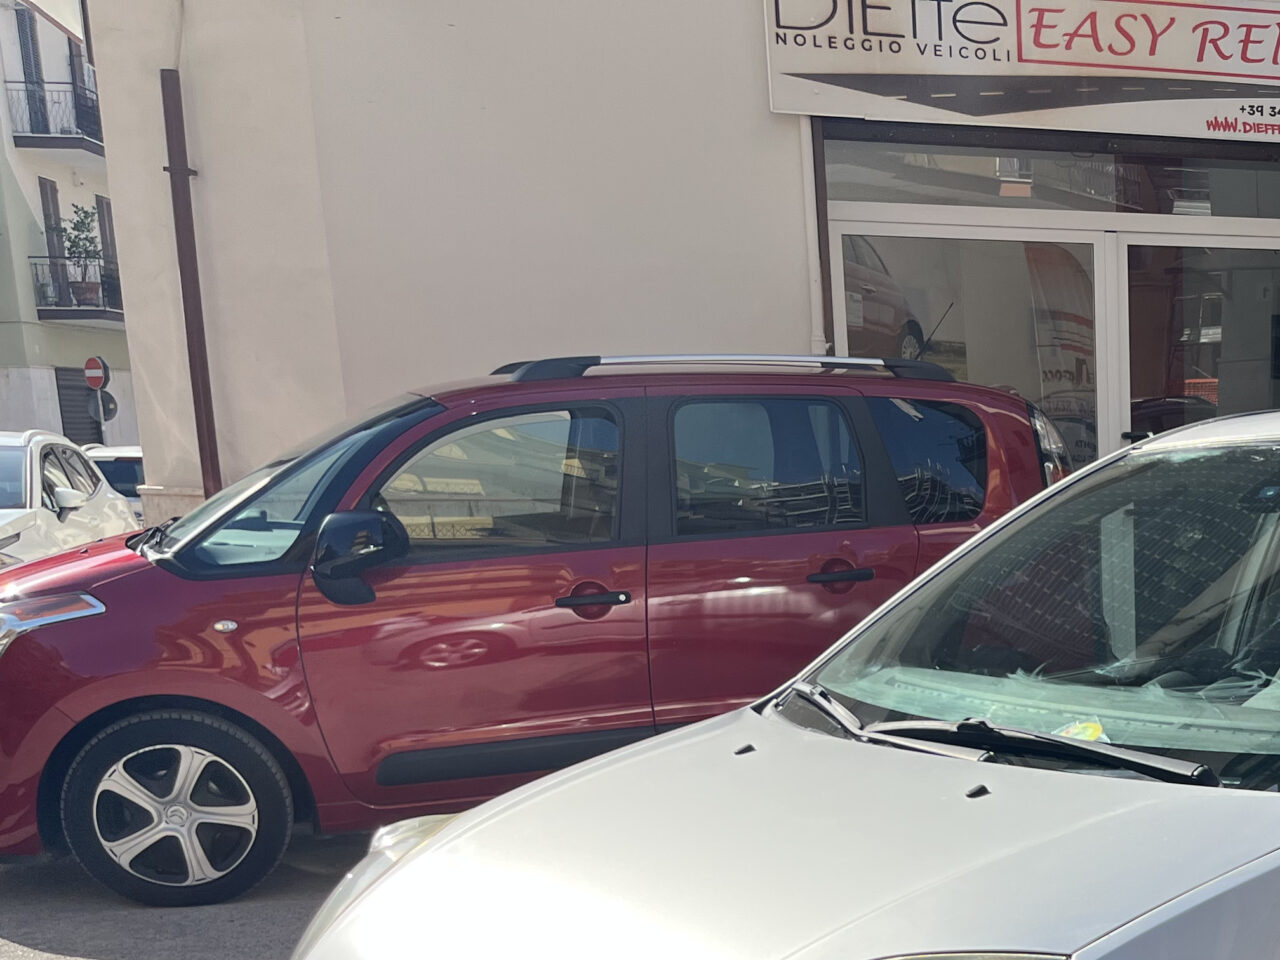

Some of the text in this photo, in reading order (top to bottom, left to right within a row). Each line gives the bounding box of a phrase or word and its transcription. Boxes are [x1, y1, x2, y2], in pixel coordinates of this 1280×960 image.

[775, 32, 1010, 62] NOLEGGIO VEICOLI
[1028, 8, 1176, 57] EASY
[1239, 105, 1264, 117] +39
